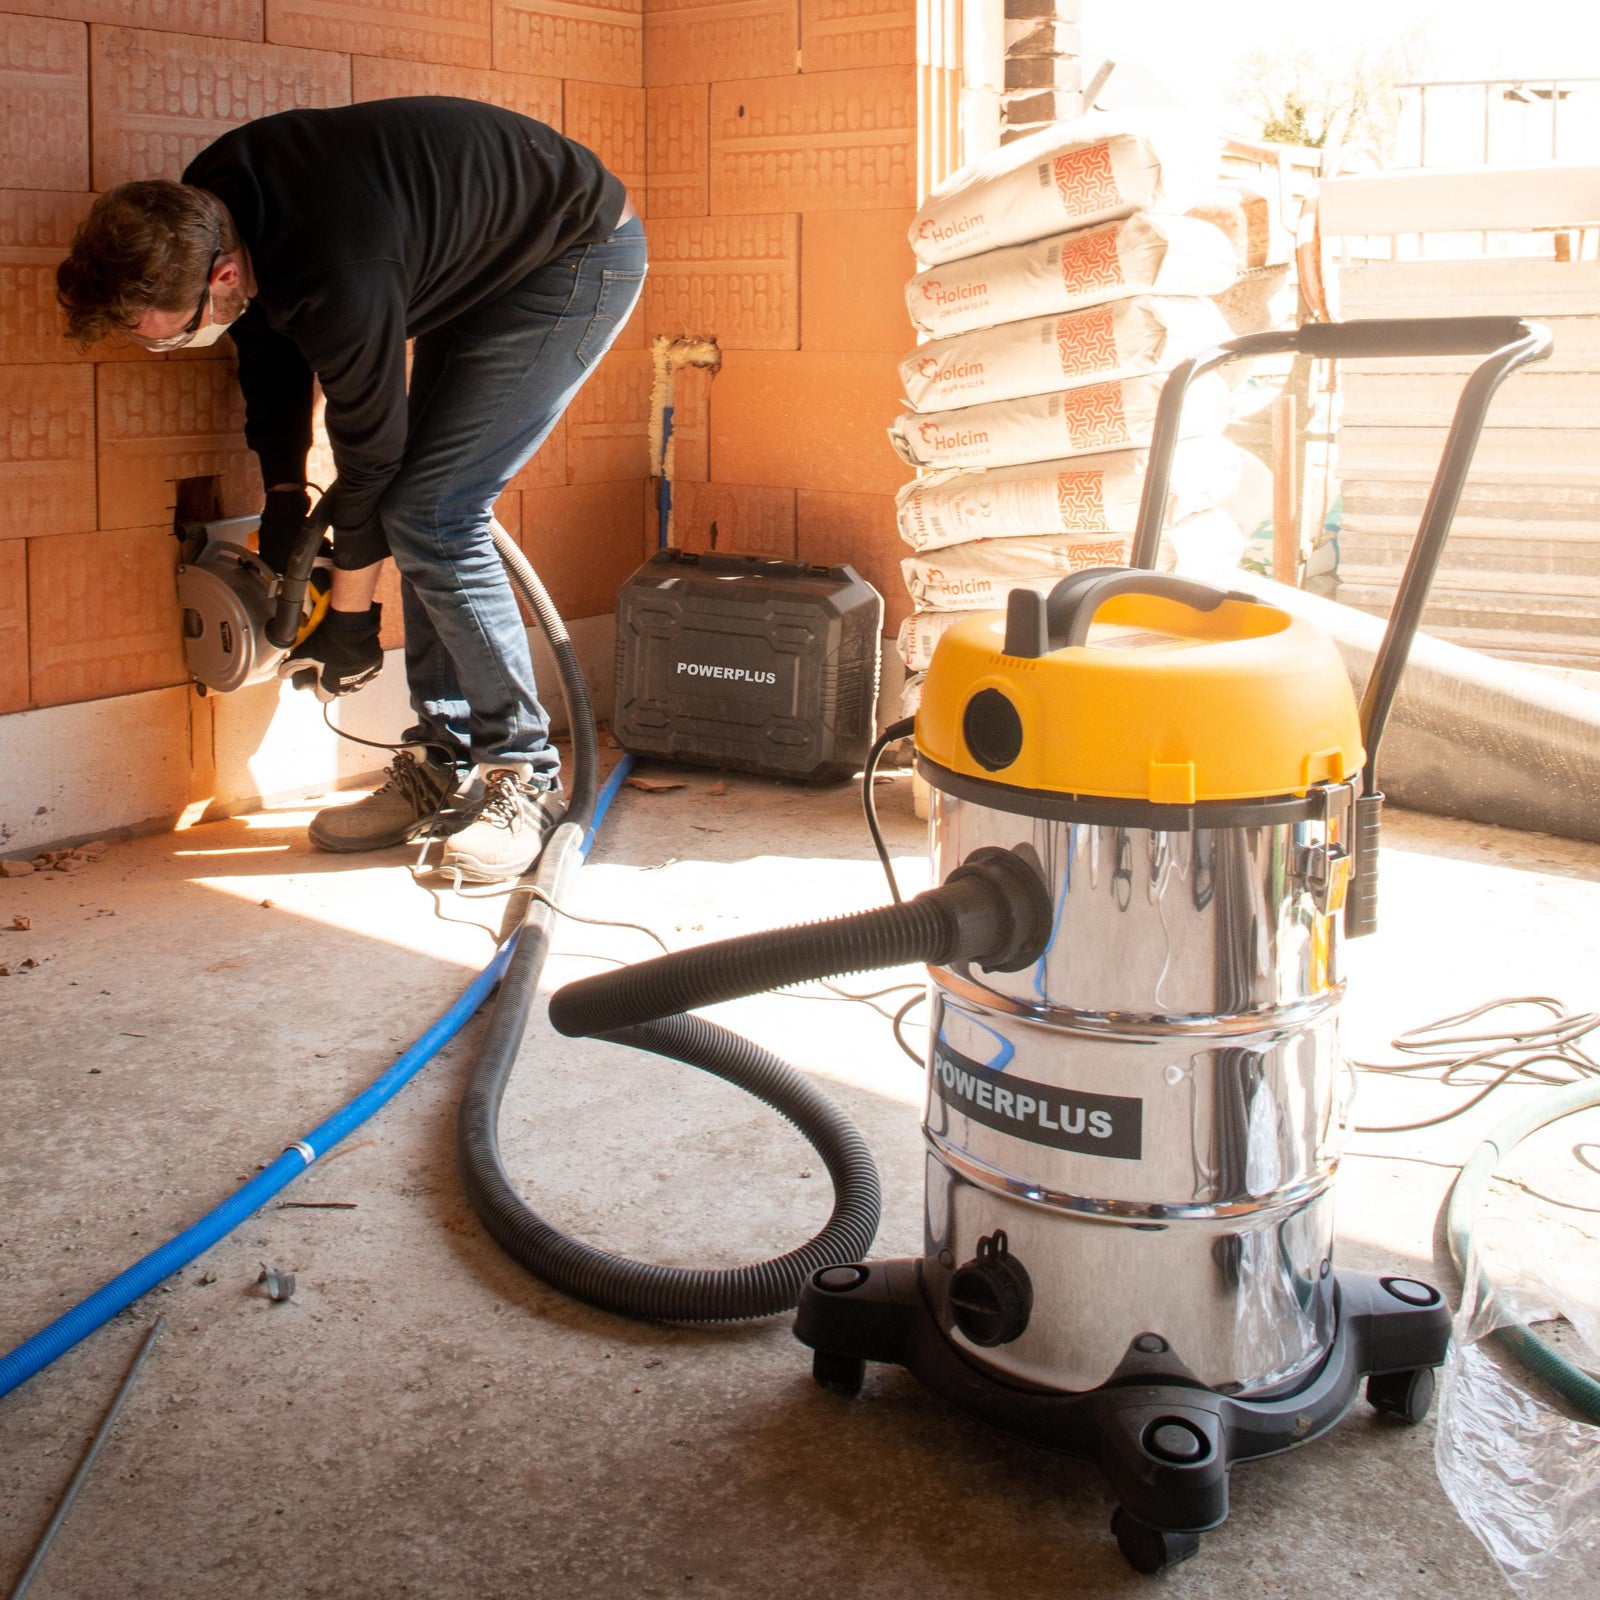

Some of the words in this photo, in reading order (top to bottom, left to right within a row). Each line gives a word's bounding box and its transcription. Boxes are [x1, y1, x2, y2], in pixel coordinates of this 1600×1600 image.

[931, 214, 985, 243] Holcim
[936, 282, 988, 306] Holcim
[932, 362, 984, 383] Holcim
[934, 430, 989, 450] Holcim
[912, 494, 929, 537] Holcim
[941, 578, 992, 595] Holcim
[676, 662, 776, 685] POWERPLUS
[934, 1052, 1114, 1138] POWERPLUS
